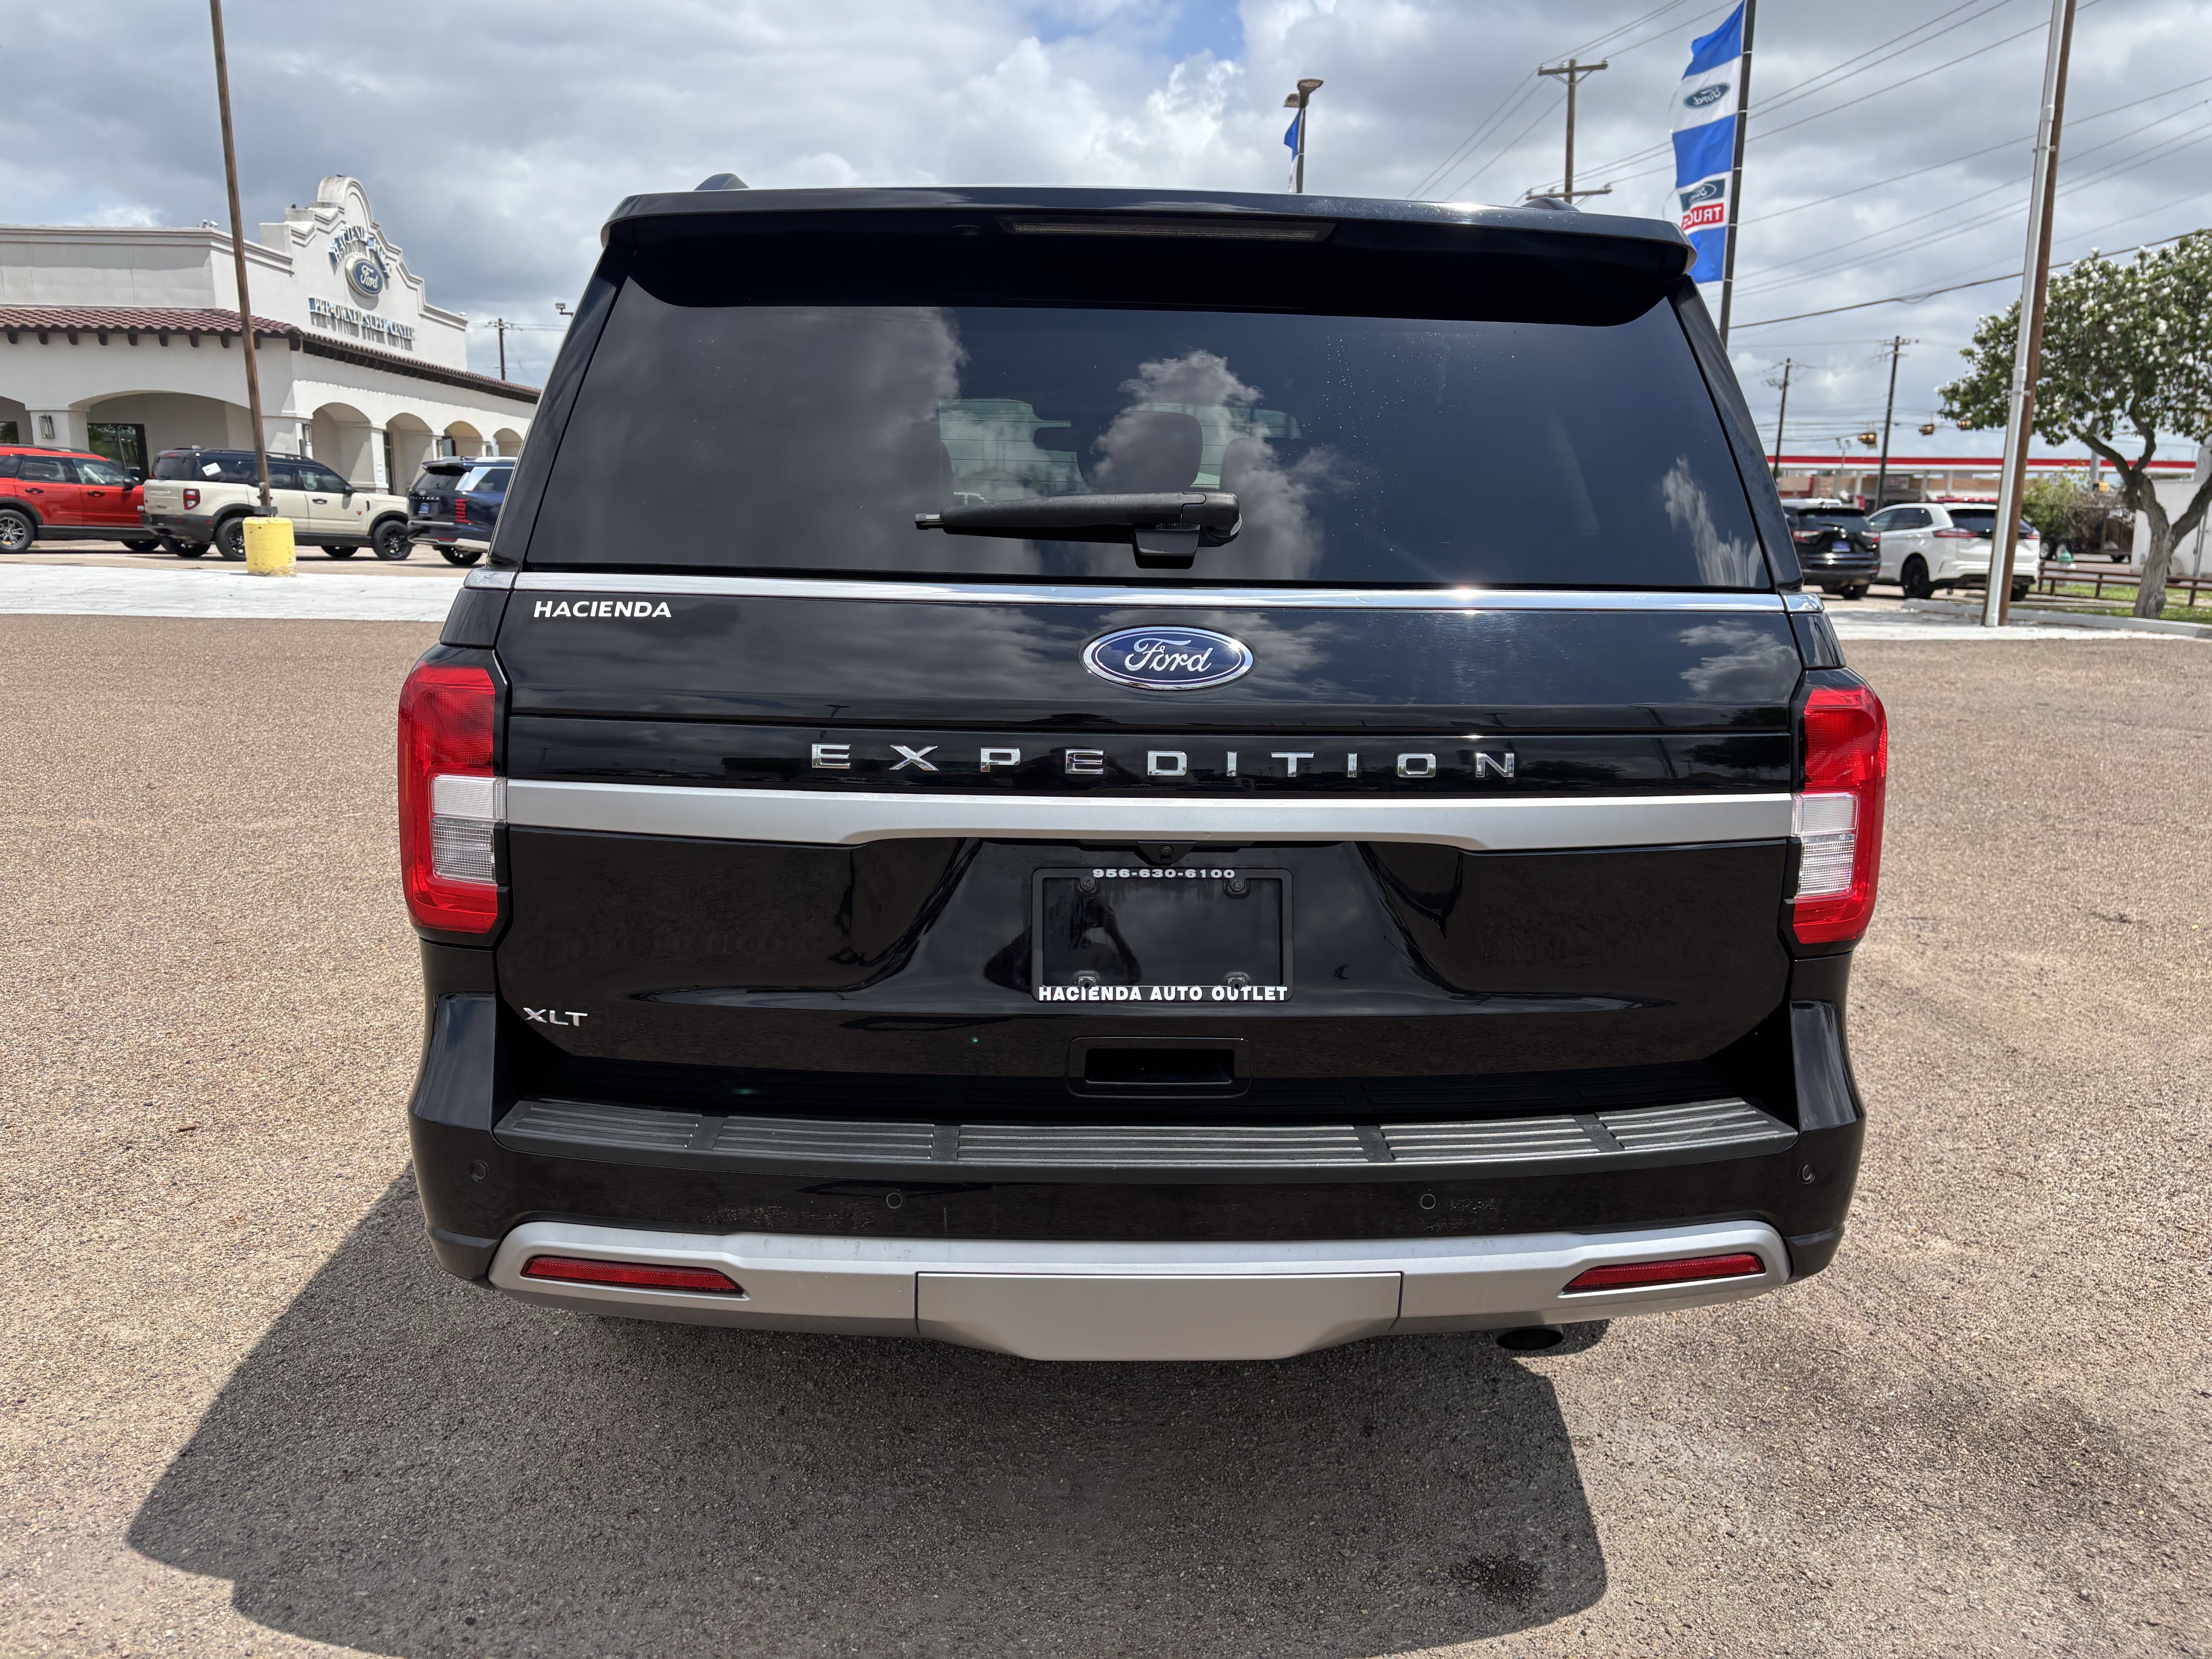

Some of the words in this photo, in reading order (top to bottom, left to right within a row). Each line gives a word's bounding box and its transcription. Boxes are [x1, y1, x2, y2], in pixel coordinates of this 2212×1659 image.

[360, 265, 379, 289] Ford
[533, 601, 672, 618] HACIENDA
[1125, 638, 1213, 672] Ford
[811, 743, 1515, 778] EXPEDITION
[1092, 869, 1236, 878] 956-630-6100
[1039, 986, 1142, 1001] HACIENDA
[1150, 986, 1202, 1001] AUTO
[1211, 986, 1288, 1001] OUTLET
[523, 1007, 588, 1027] XLT
